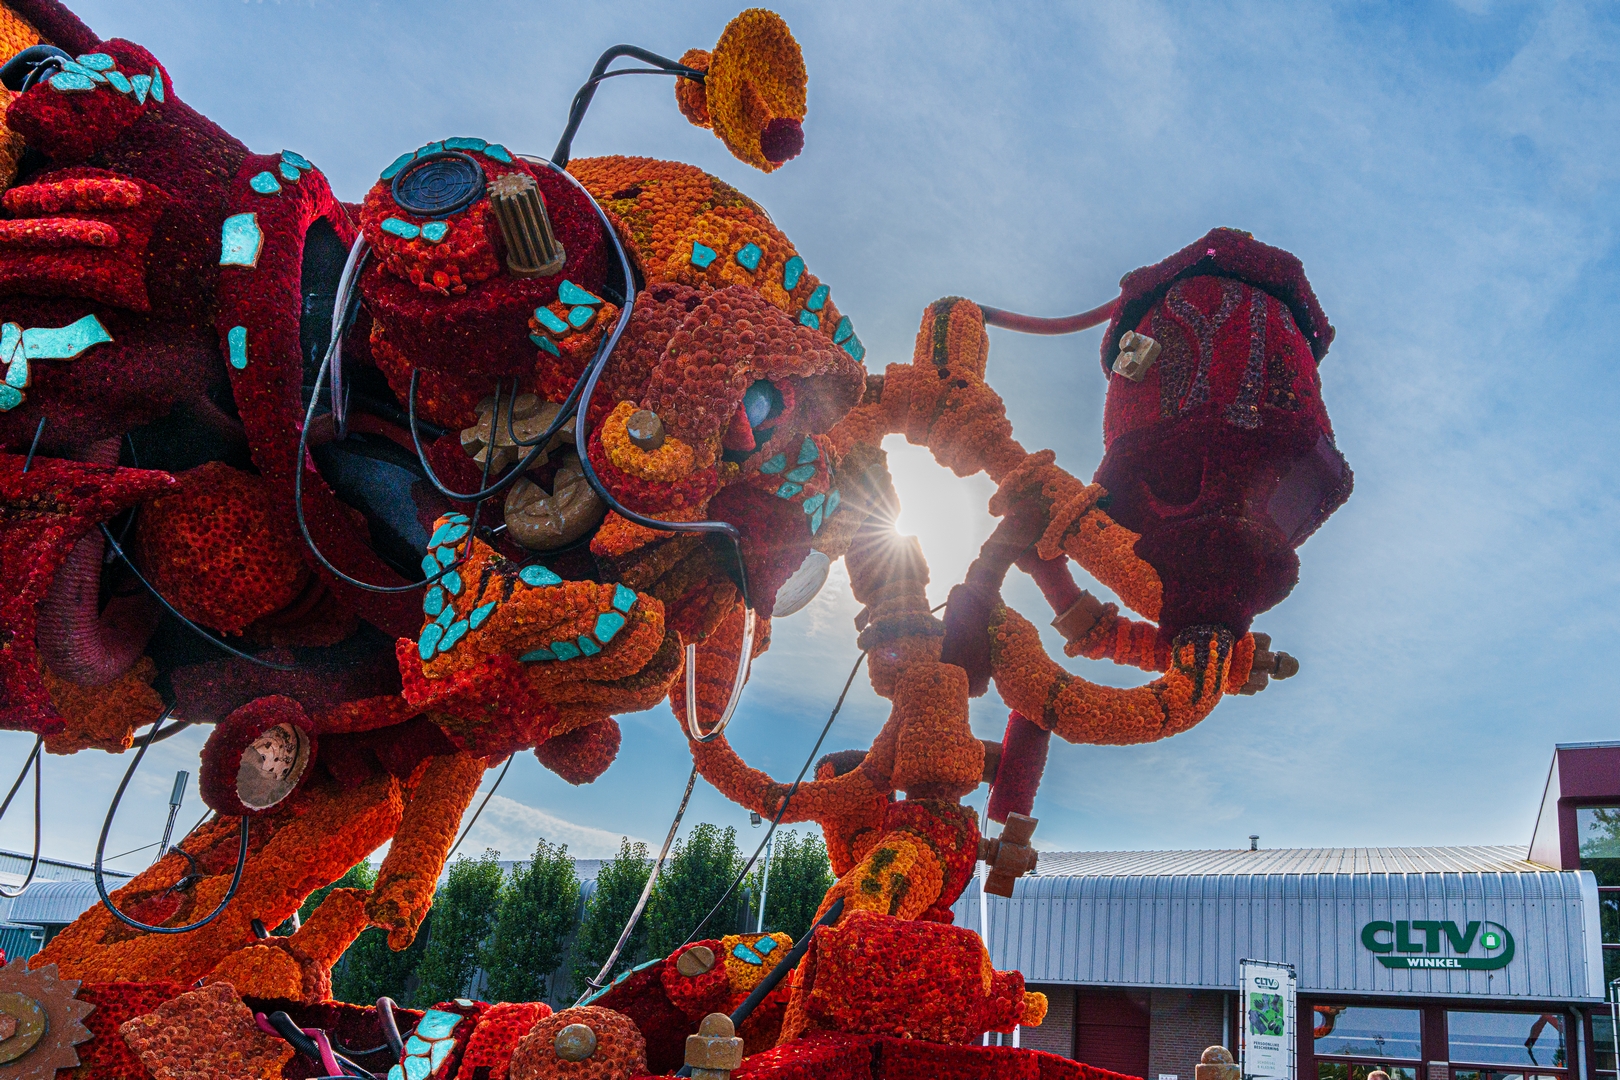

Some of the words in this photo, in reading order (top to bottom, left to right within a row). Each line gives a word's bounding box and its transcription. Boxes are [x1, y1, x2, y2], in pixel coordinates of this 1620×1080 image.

[1361, 920, 1481, 953] CLTV
[1406, 958, 1461, 968] WINKEL
[1254, 977, 1274, 986] CLTV
